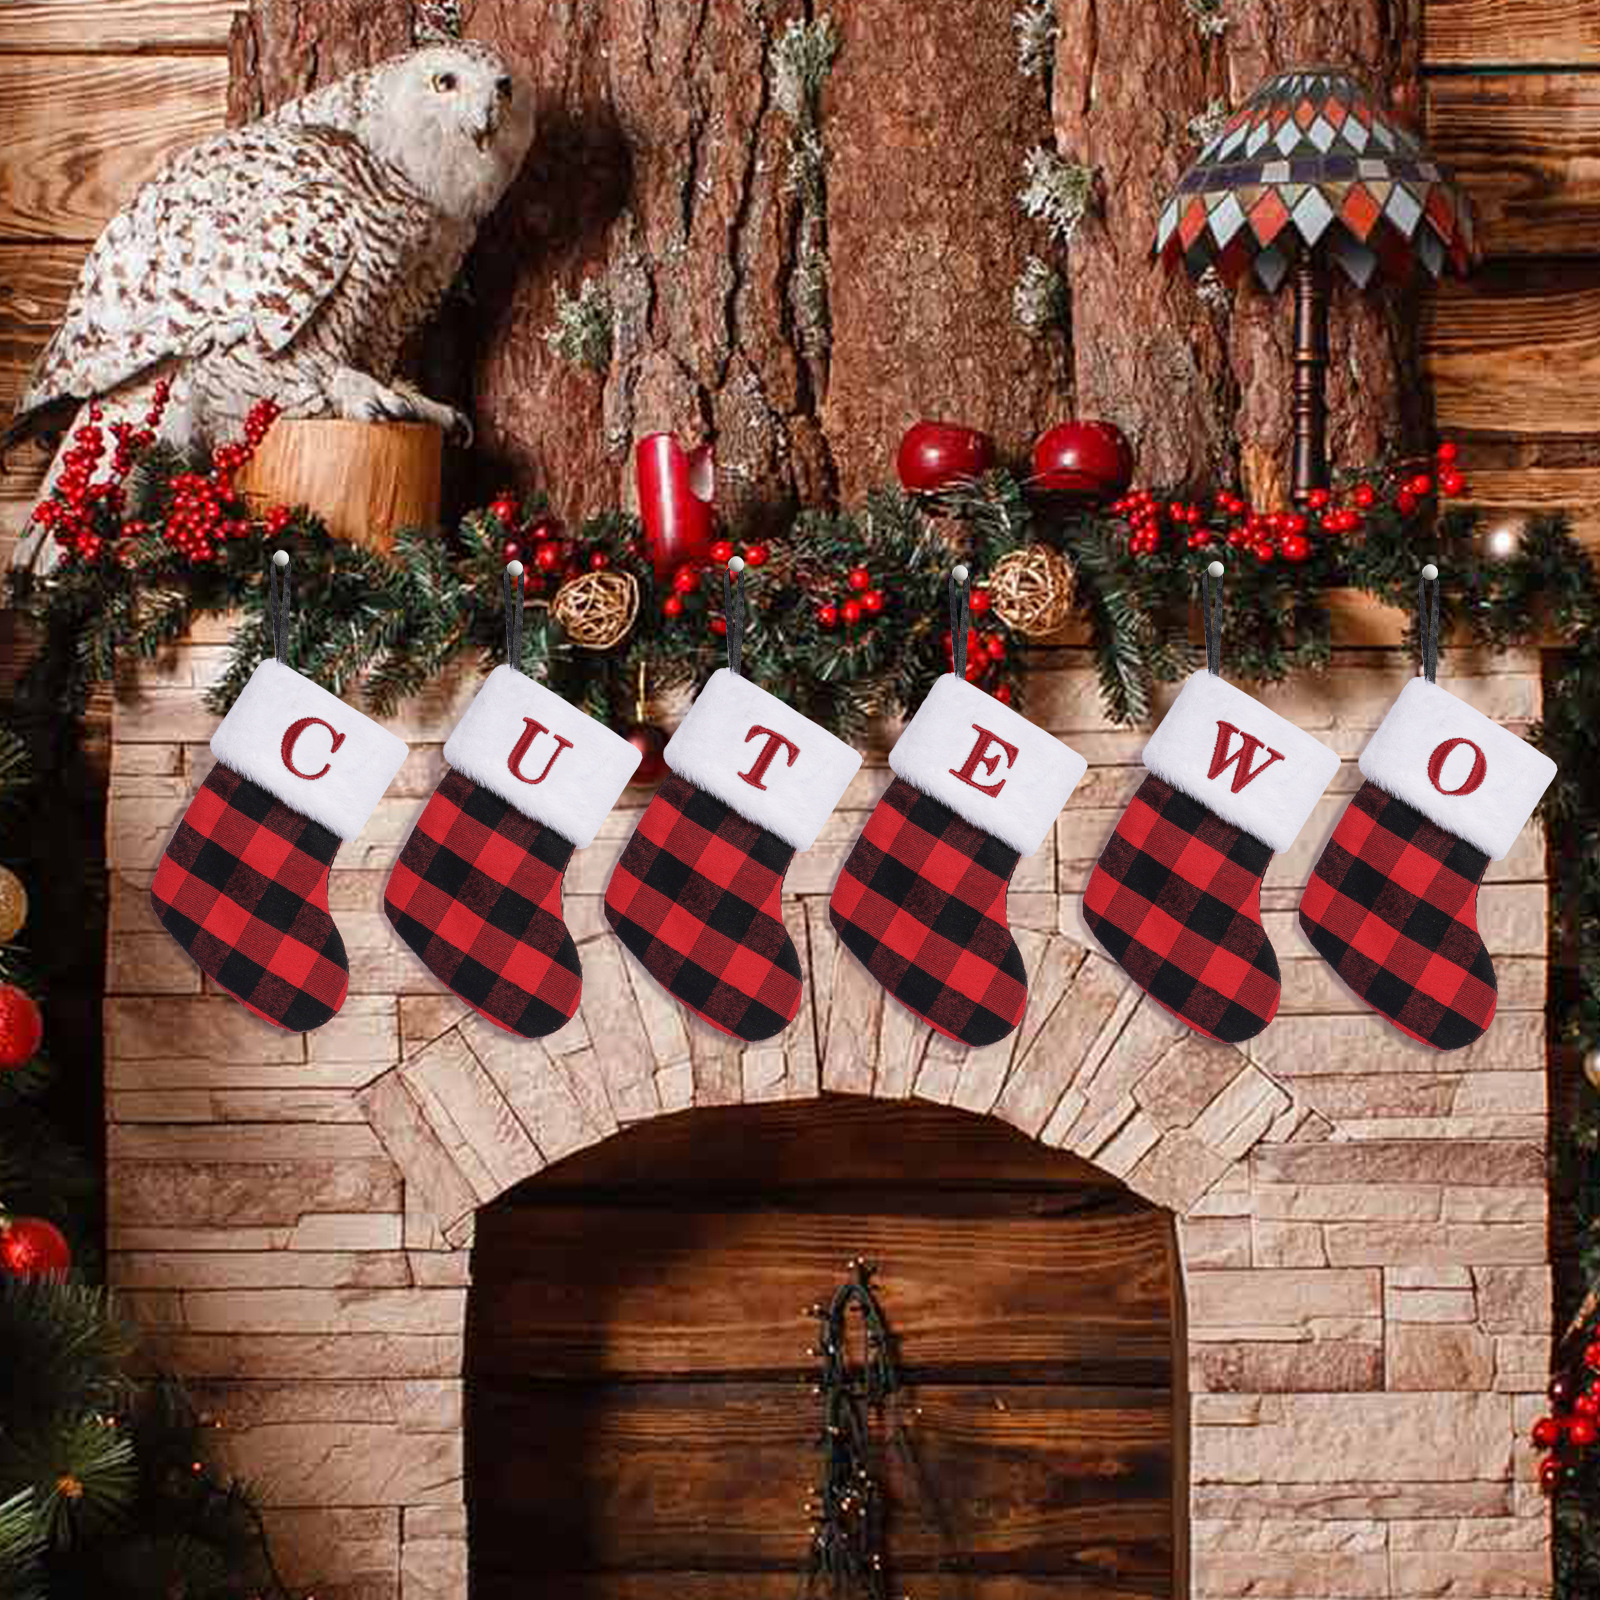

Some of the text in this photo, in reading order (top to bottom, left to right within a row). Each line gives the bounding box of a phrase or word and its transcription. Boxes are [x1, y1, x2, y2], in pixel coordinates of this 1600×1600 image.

[281, 717, 347, 781] C
[508, 717, 574, 785] U
[737, 725, 800, 791] T
[949, 724, 1019, 798] E
[1207, 720, 1285, 793] W
[1428, 738, 1488, 797] O
